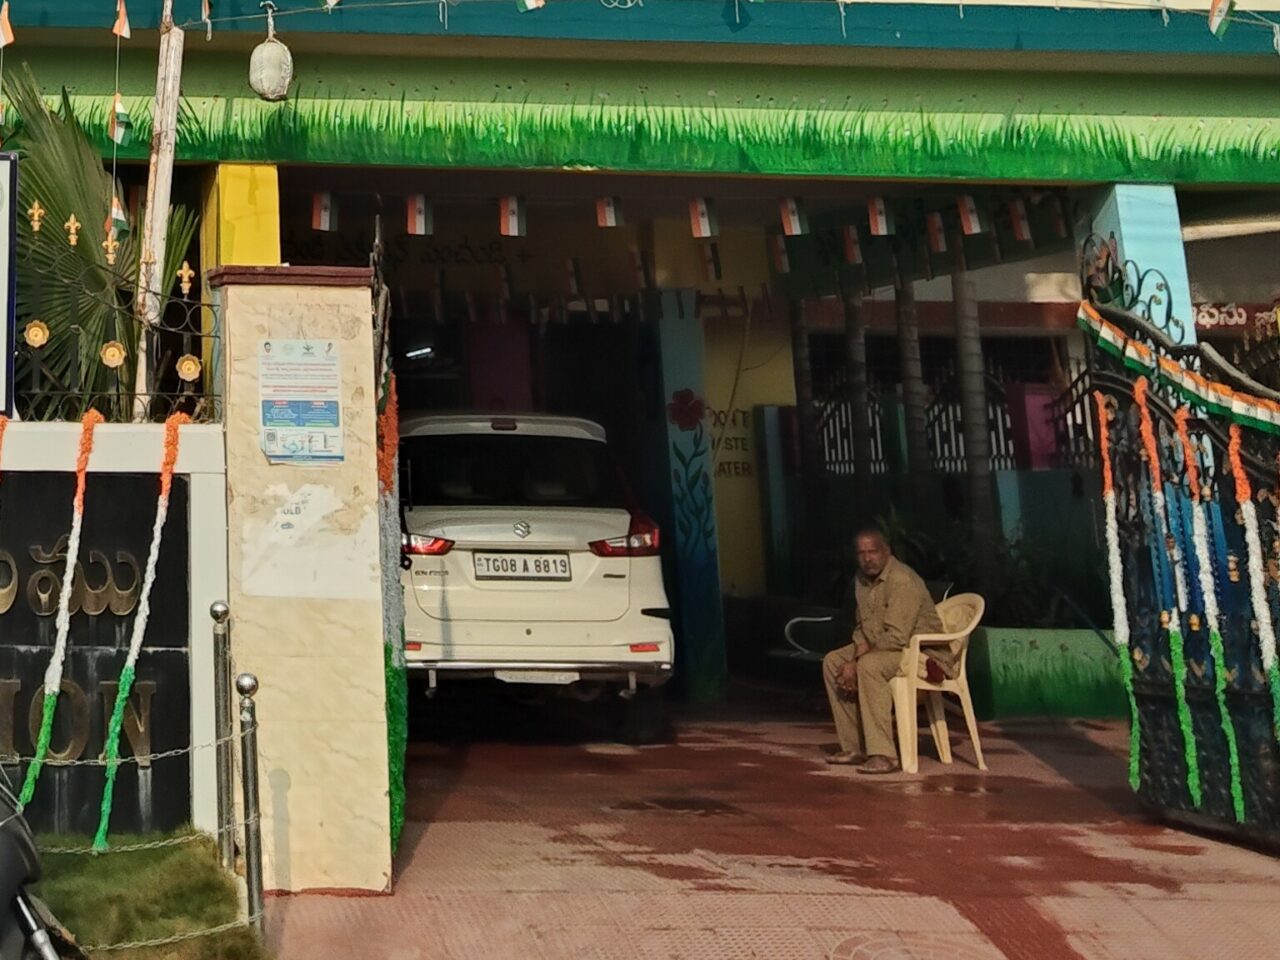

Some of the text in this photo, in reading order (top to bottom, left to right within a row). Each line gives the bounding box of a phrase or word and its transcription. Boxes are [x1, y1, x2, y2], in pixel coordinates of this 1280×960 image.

[483, 557, 517, 573] TG08
[522, 558, 530, 573] A
[534, 558, 568, 574] 8819
